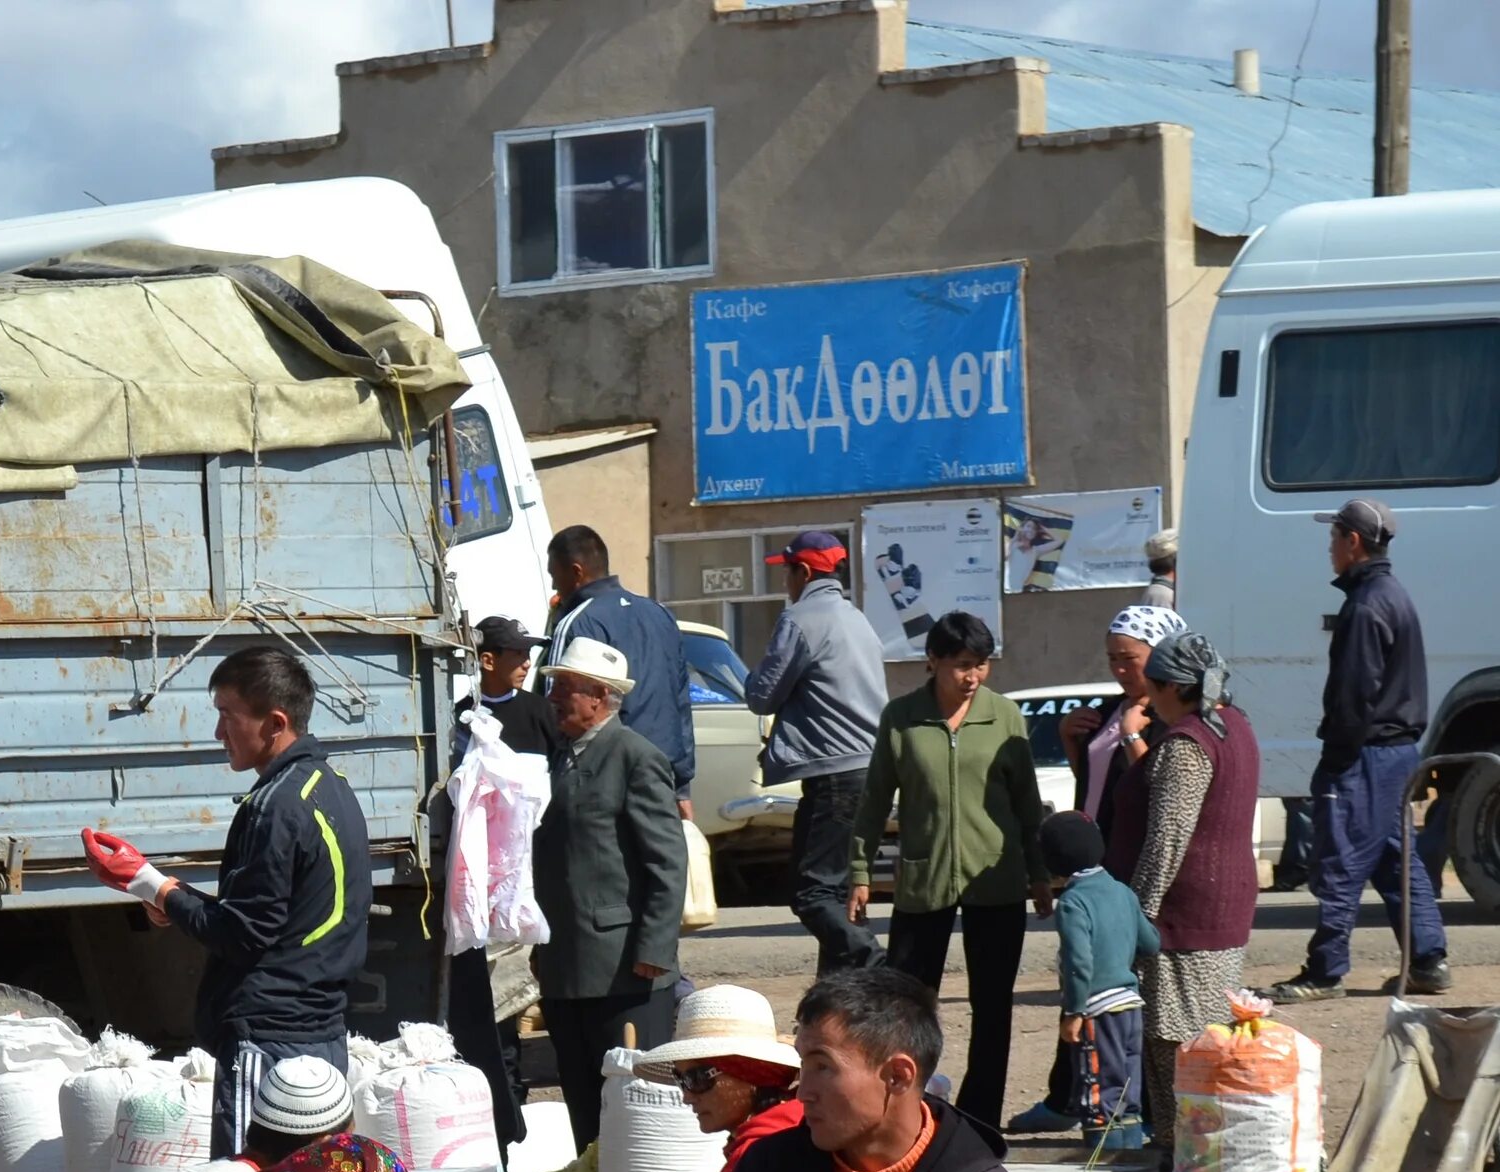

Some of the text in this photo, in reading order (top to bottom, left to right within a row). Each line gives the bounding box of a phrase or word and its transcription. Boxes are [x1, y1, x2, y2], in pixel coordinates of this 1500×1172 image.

[947, 279, 1012, 302] Кафеси
[706, 297, 767, 322] Кафе
[941, 461, 1016, 480] Магазин
[958, 527, 990, 536] Beeline
